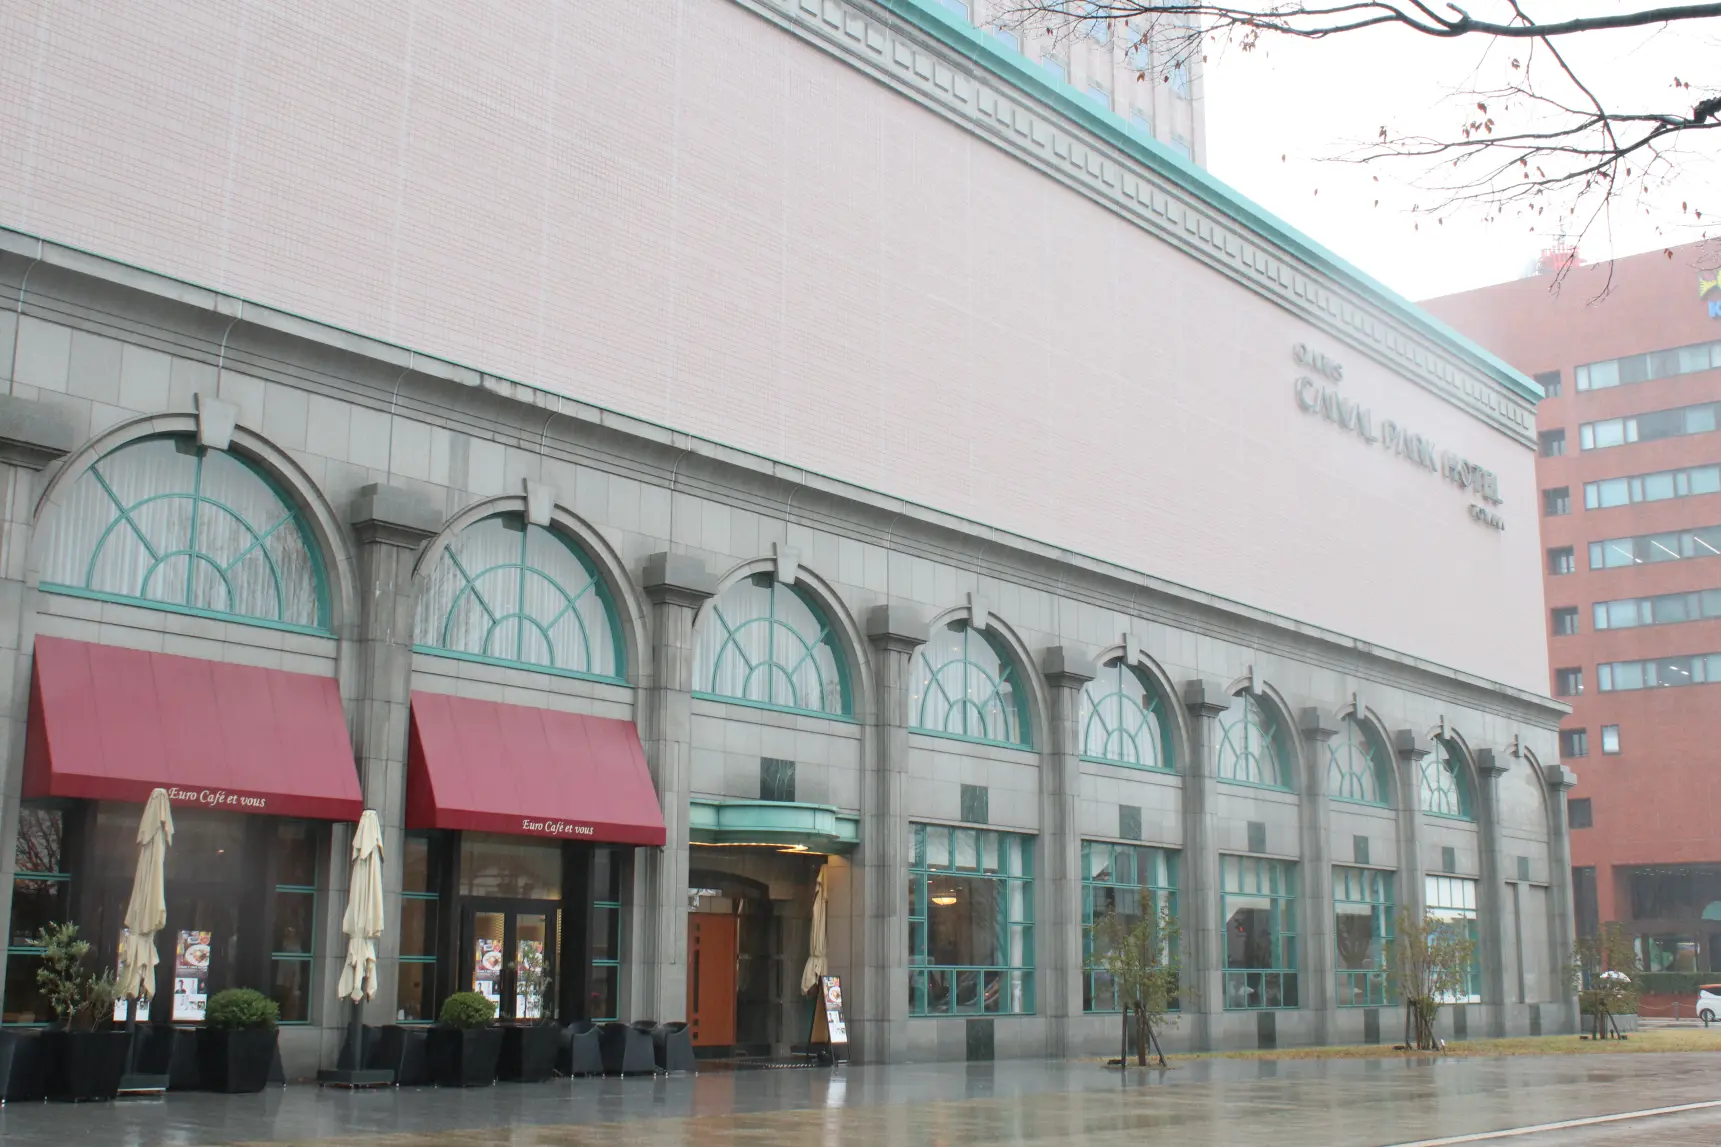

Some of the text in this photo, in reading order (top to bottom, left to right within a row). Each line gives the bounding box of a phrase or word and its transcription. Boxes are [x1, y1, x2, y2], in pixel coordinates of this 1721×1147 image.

[1294, 375, 1504, 507] CANAL PARK HOTEL
[168, 787, 266, 808] Euro Café et vous
[522, 819, 594, 835] Euro Café et vous
